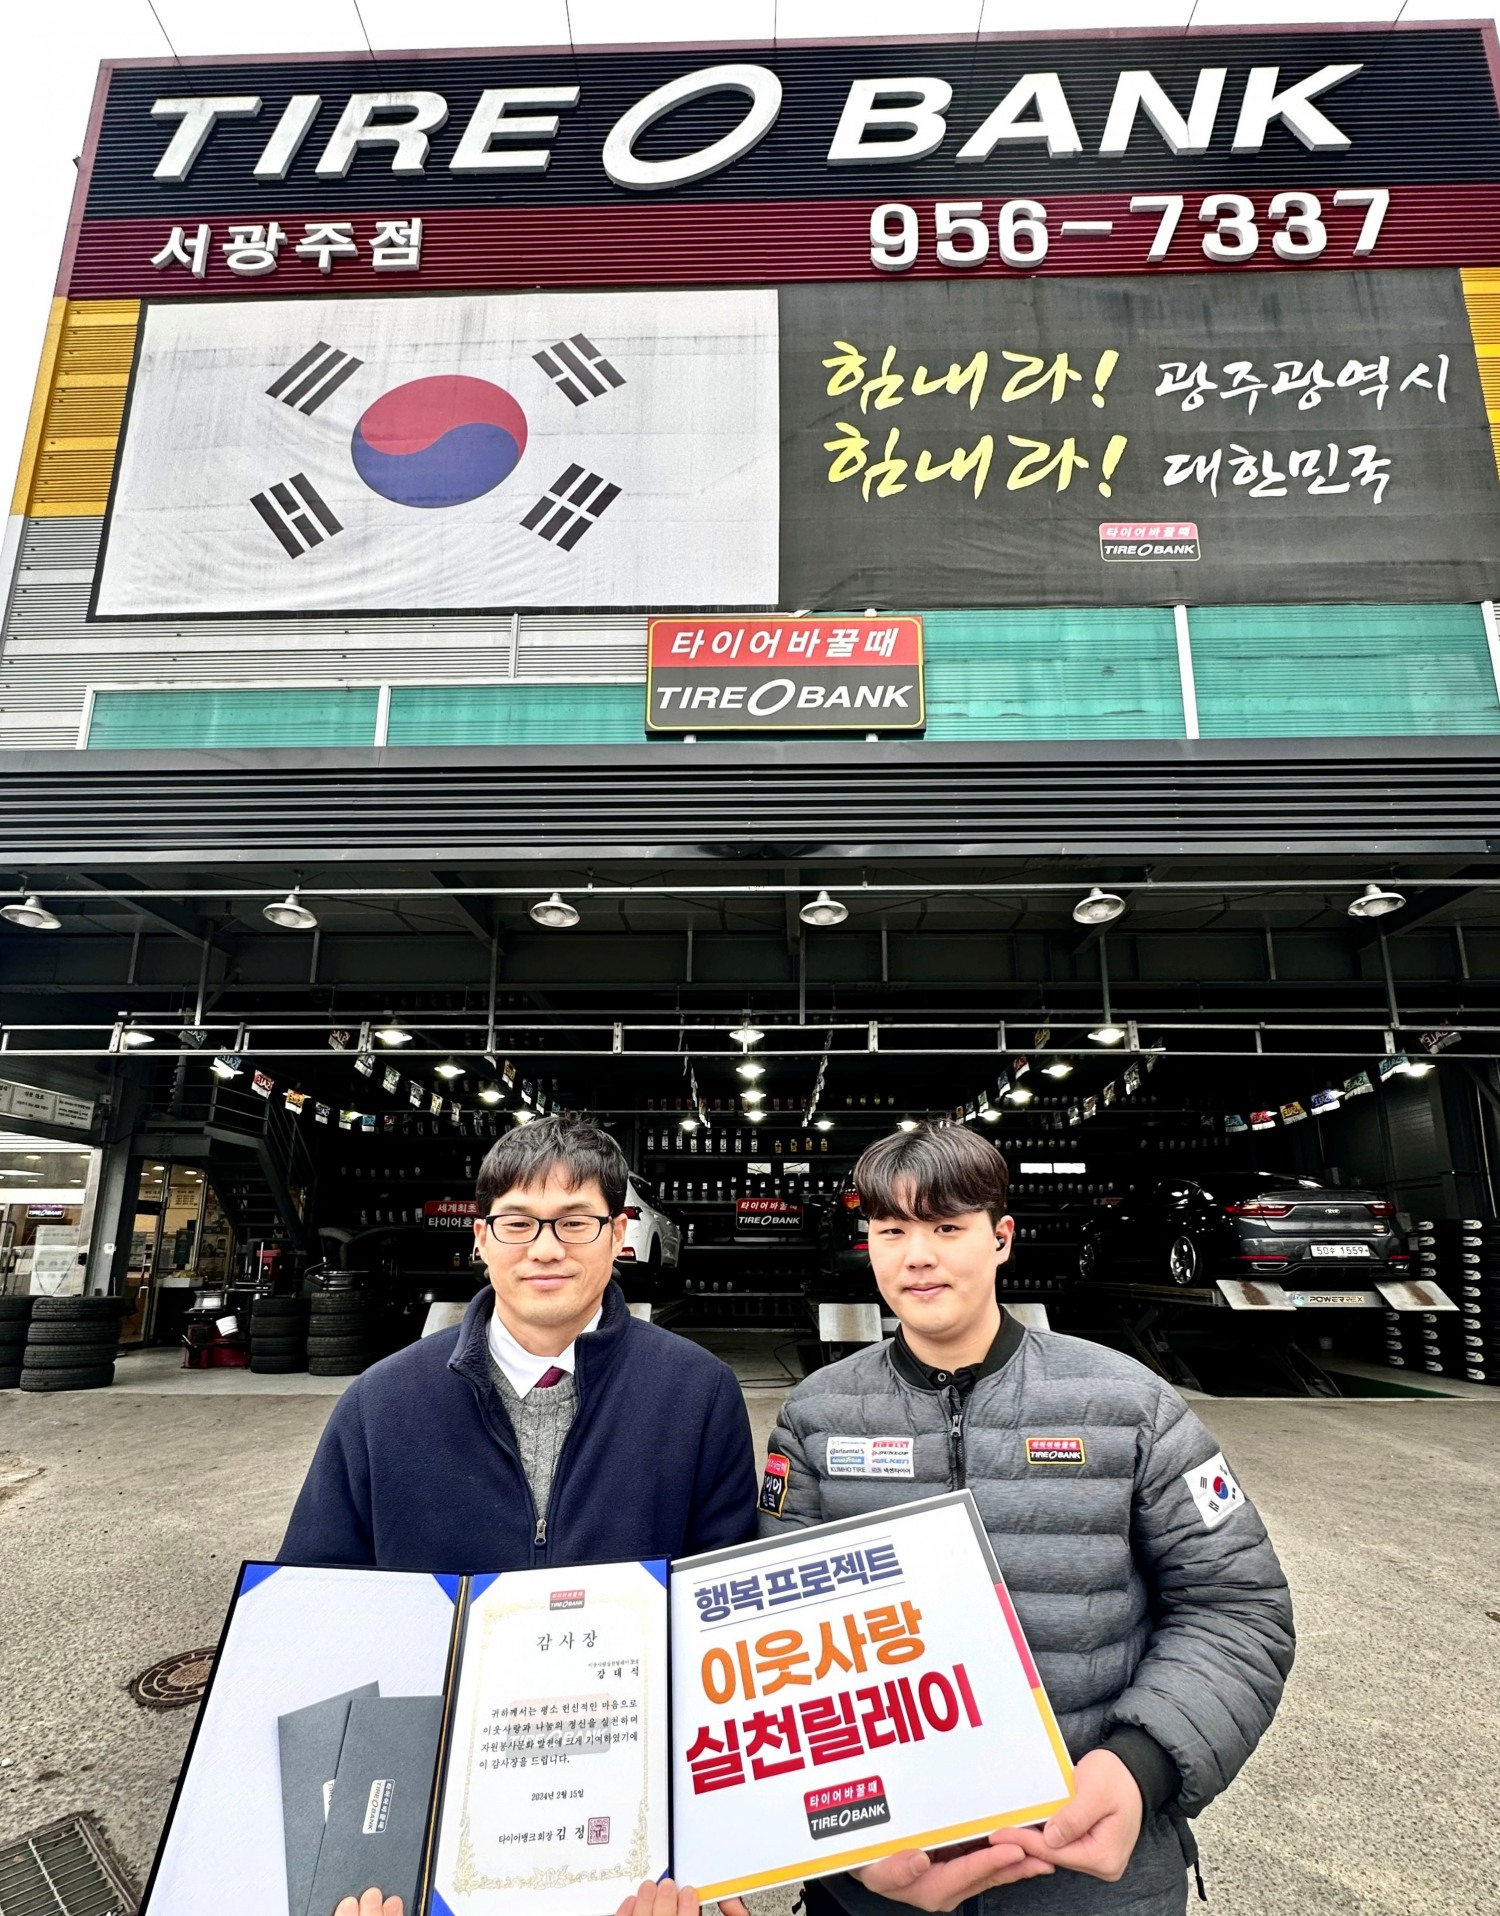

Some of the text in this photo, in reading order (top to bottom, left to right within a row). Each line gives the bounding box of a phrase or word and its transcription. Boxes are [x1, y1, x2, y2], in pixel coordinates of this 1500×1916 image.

[869, 188, 1389, 271] 956-7337
[150, 217, 422, 278] 서광주점
[822, 340, 1449, 416] 힘내라! 광주광역시
[823, 422, 1392, 504] 힘내라! 대한민국
[438, 1203, 477, 1213] 세계최초
[1340, 1246, 1363, 1255] 1559
[701, 1600, 926, 1705] 이웃사랑
[491, 1699, 638, 1719] 귀하께서는 평소 헌신적인 마음으로
[483, 1714, 638, 1736] 이웃사랑과 나눔의 정신을 실천하며
[685, 1663, 983, 1795] 실천릴레이
[537, 1736, 562, 1749] 발전에
[565, 1735, 583, 1746] 크게
[586, 1731, 638, 1745] 기여하였기에
[479, 1753, 570, 1770] 이 감사장을 드립니다.
[531, 1788, 584, 1801] 2024년 2월 15일
